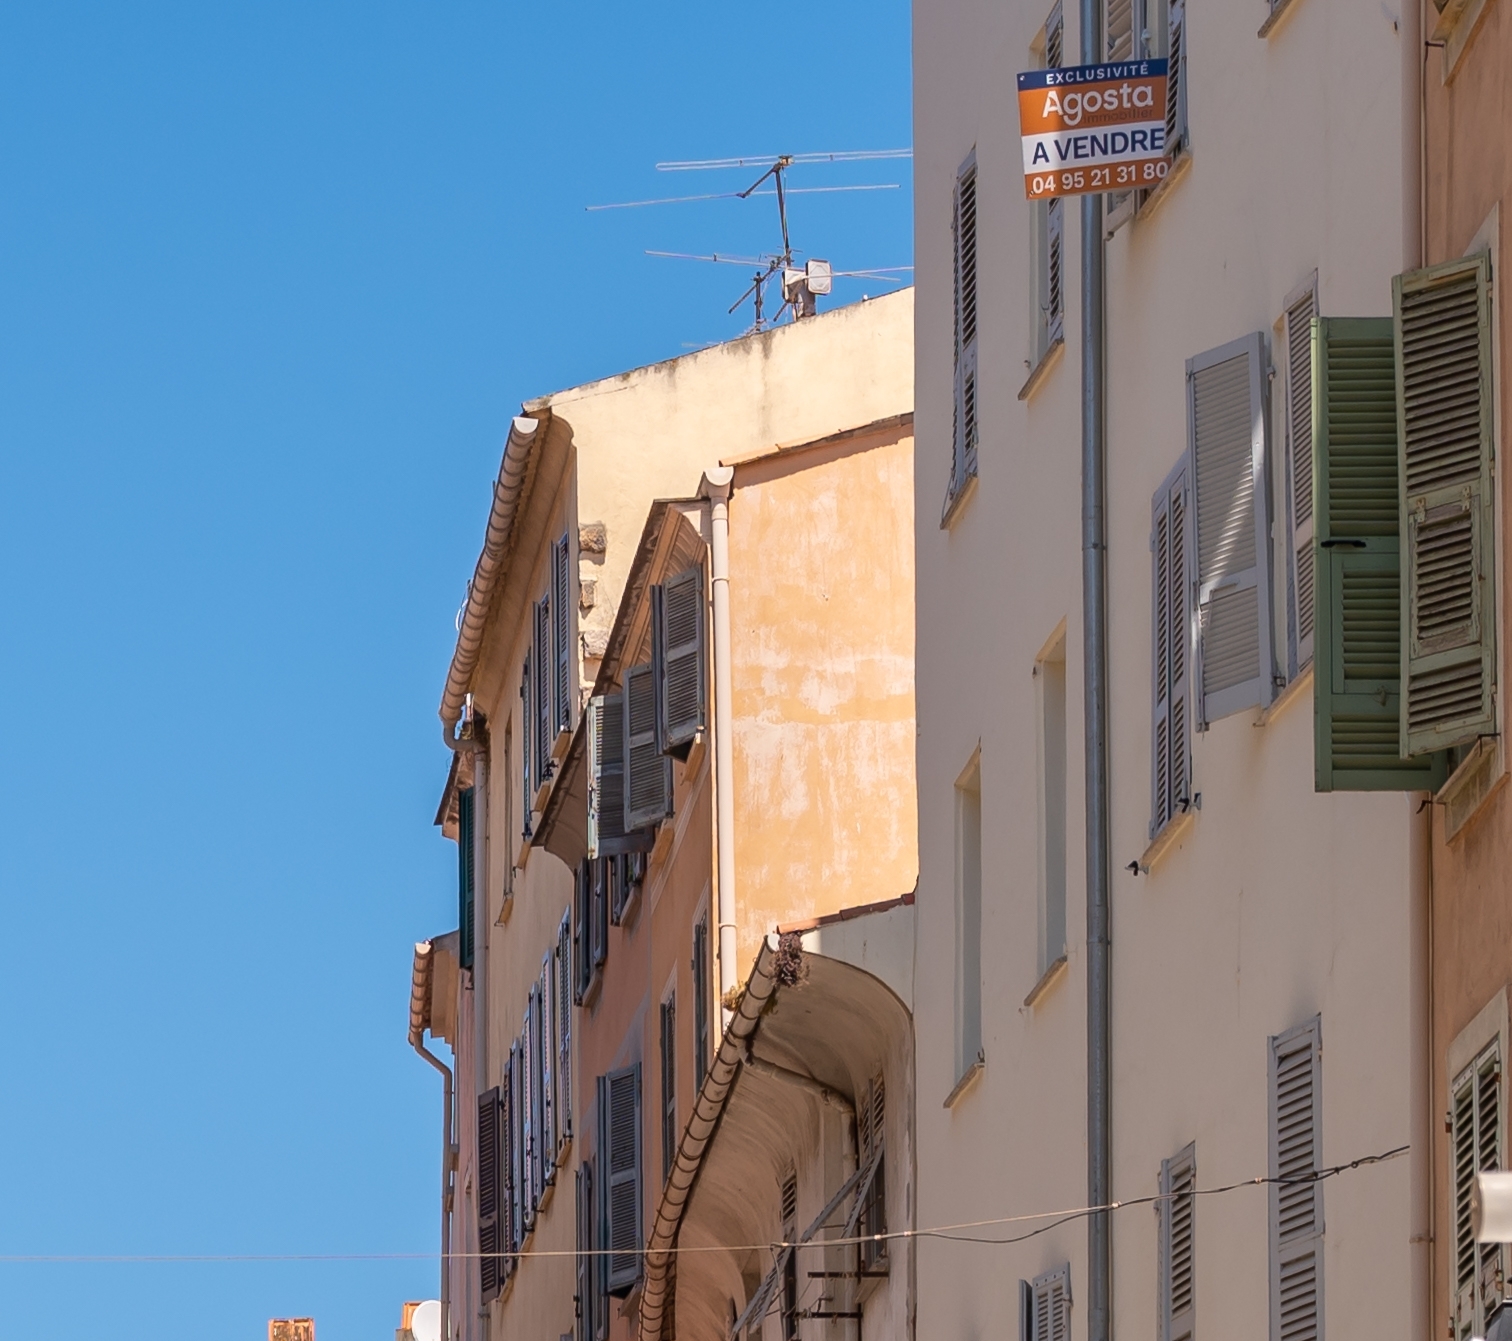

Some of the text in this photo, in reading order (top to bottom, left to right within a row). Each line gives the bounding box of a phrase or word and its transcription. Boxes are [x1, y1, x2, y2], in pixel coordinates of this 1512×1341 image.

[1046, 62, 1149, 85] EXCLUSIVITÉ
[1042, 82, 1154, 126] Agosta
[1083, 108, 1154, 124] immobilier
[1032, 127, 1165, 166] A VENDRE
[1032, 161, 1168, 194] 04 95 21 31 80
